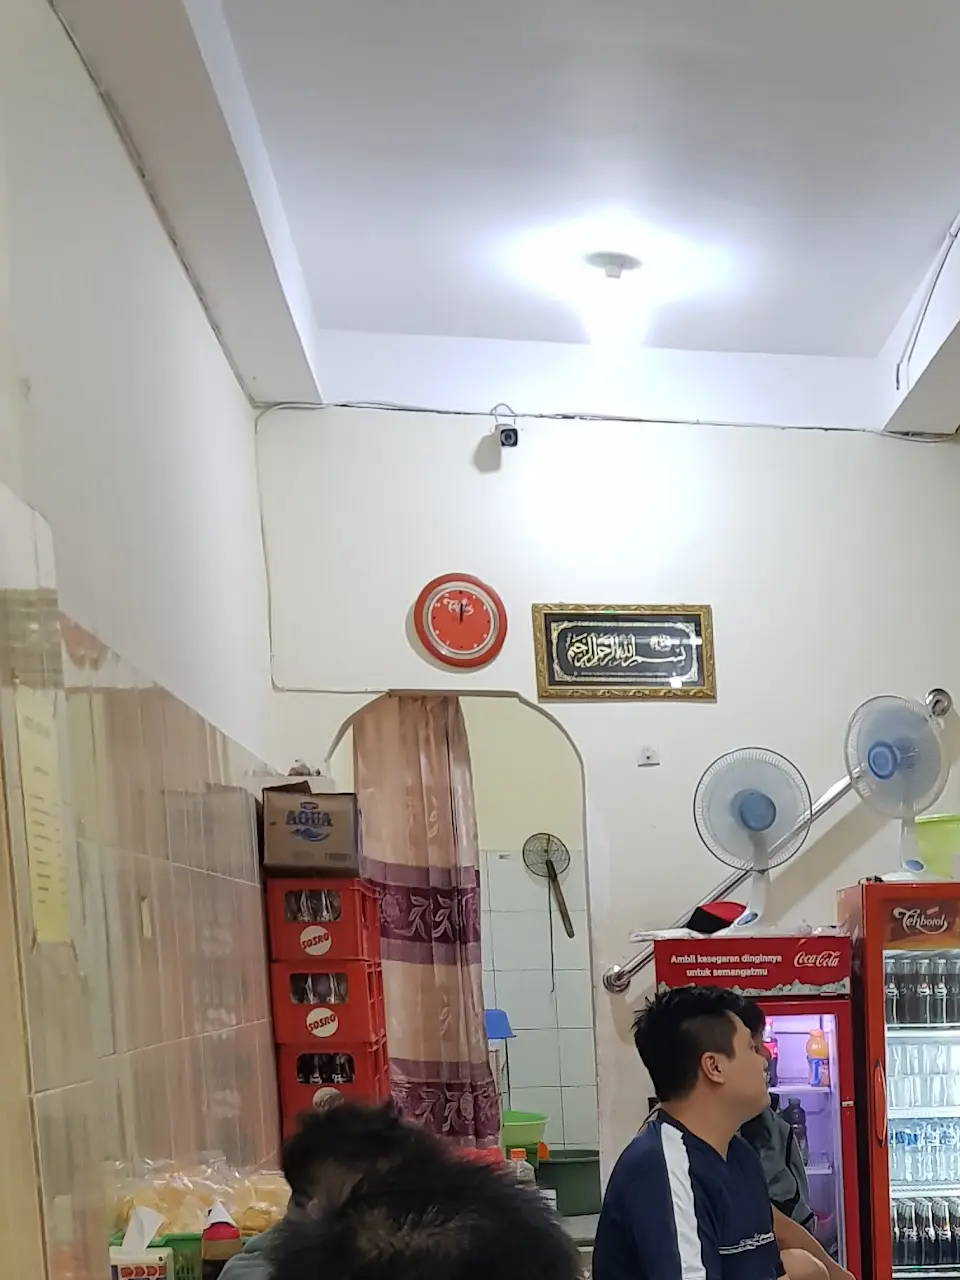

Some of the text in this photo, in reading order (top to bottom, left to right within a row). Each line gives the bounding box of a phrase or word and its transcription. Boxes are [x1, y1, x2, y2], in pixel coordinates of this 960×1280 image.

[286, 810, 334, 827] AQUA
[302, 933, 330, 949] SOSRO
[671, 955, 782, 964] Ambil kesegaran dinginnya
[686, 969, 768, 977] untuk semangatmu
[309, 1014, 336, 1031] SOSRO
